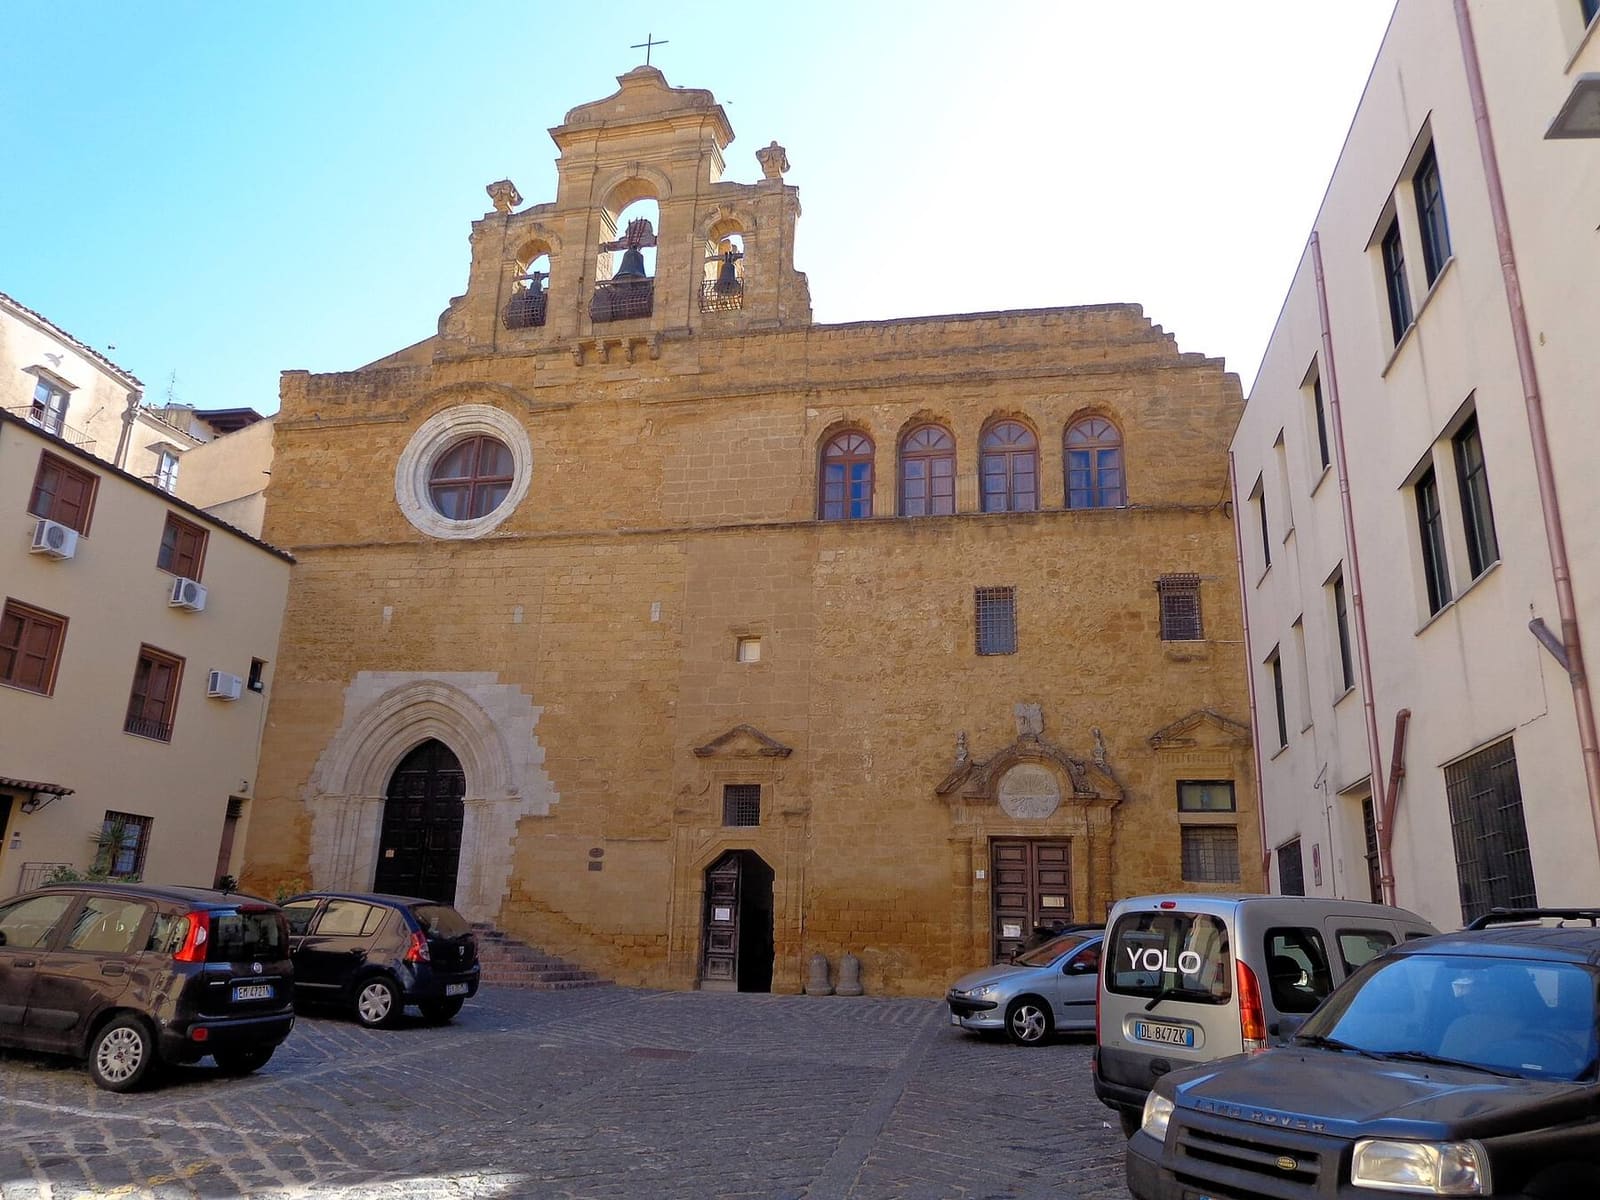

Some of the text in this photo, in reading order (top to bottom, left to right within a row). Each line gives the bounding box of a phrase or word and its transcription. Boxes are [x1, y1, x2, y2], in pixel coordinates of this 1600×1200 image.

[1126, 946, 1201, 974] YOLO
[1141, 1024, 1185, 1044] DL 847ZK
[1251, 1110, 1326, 1132] ROVER
